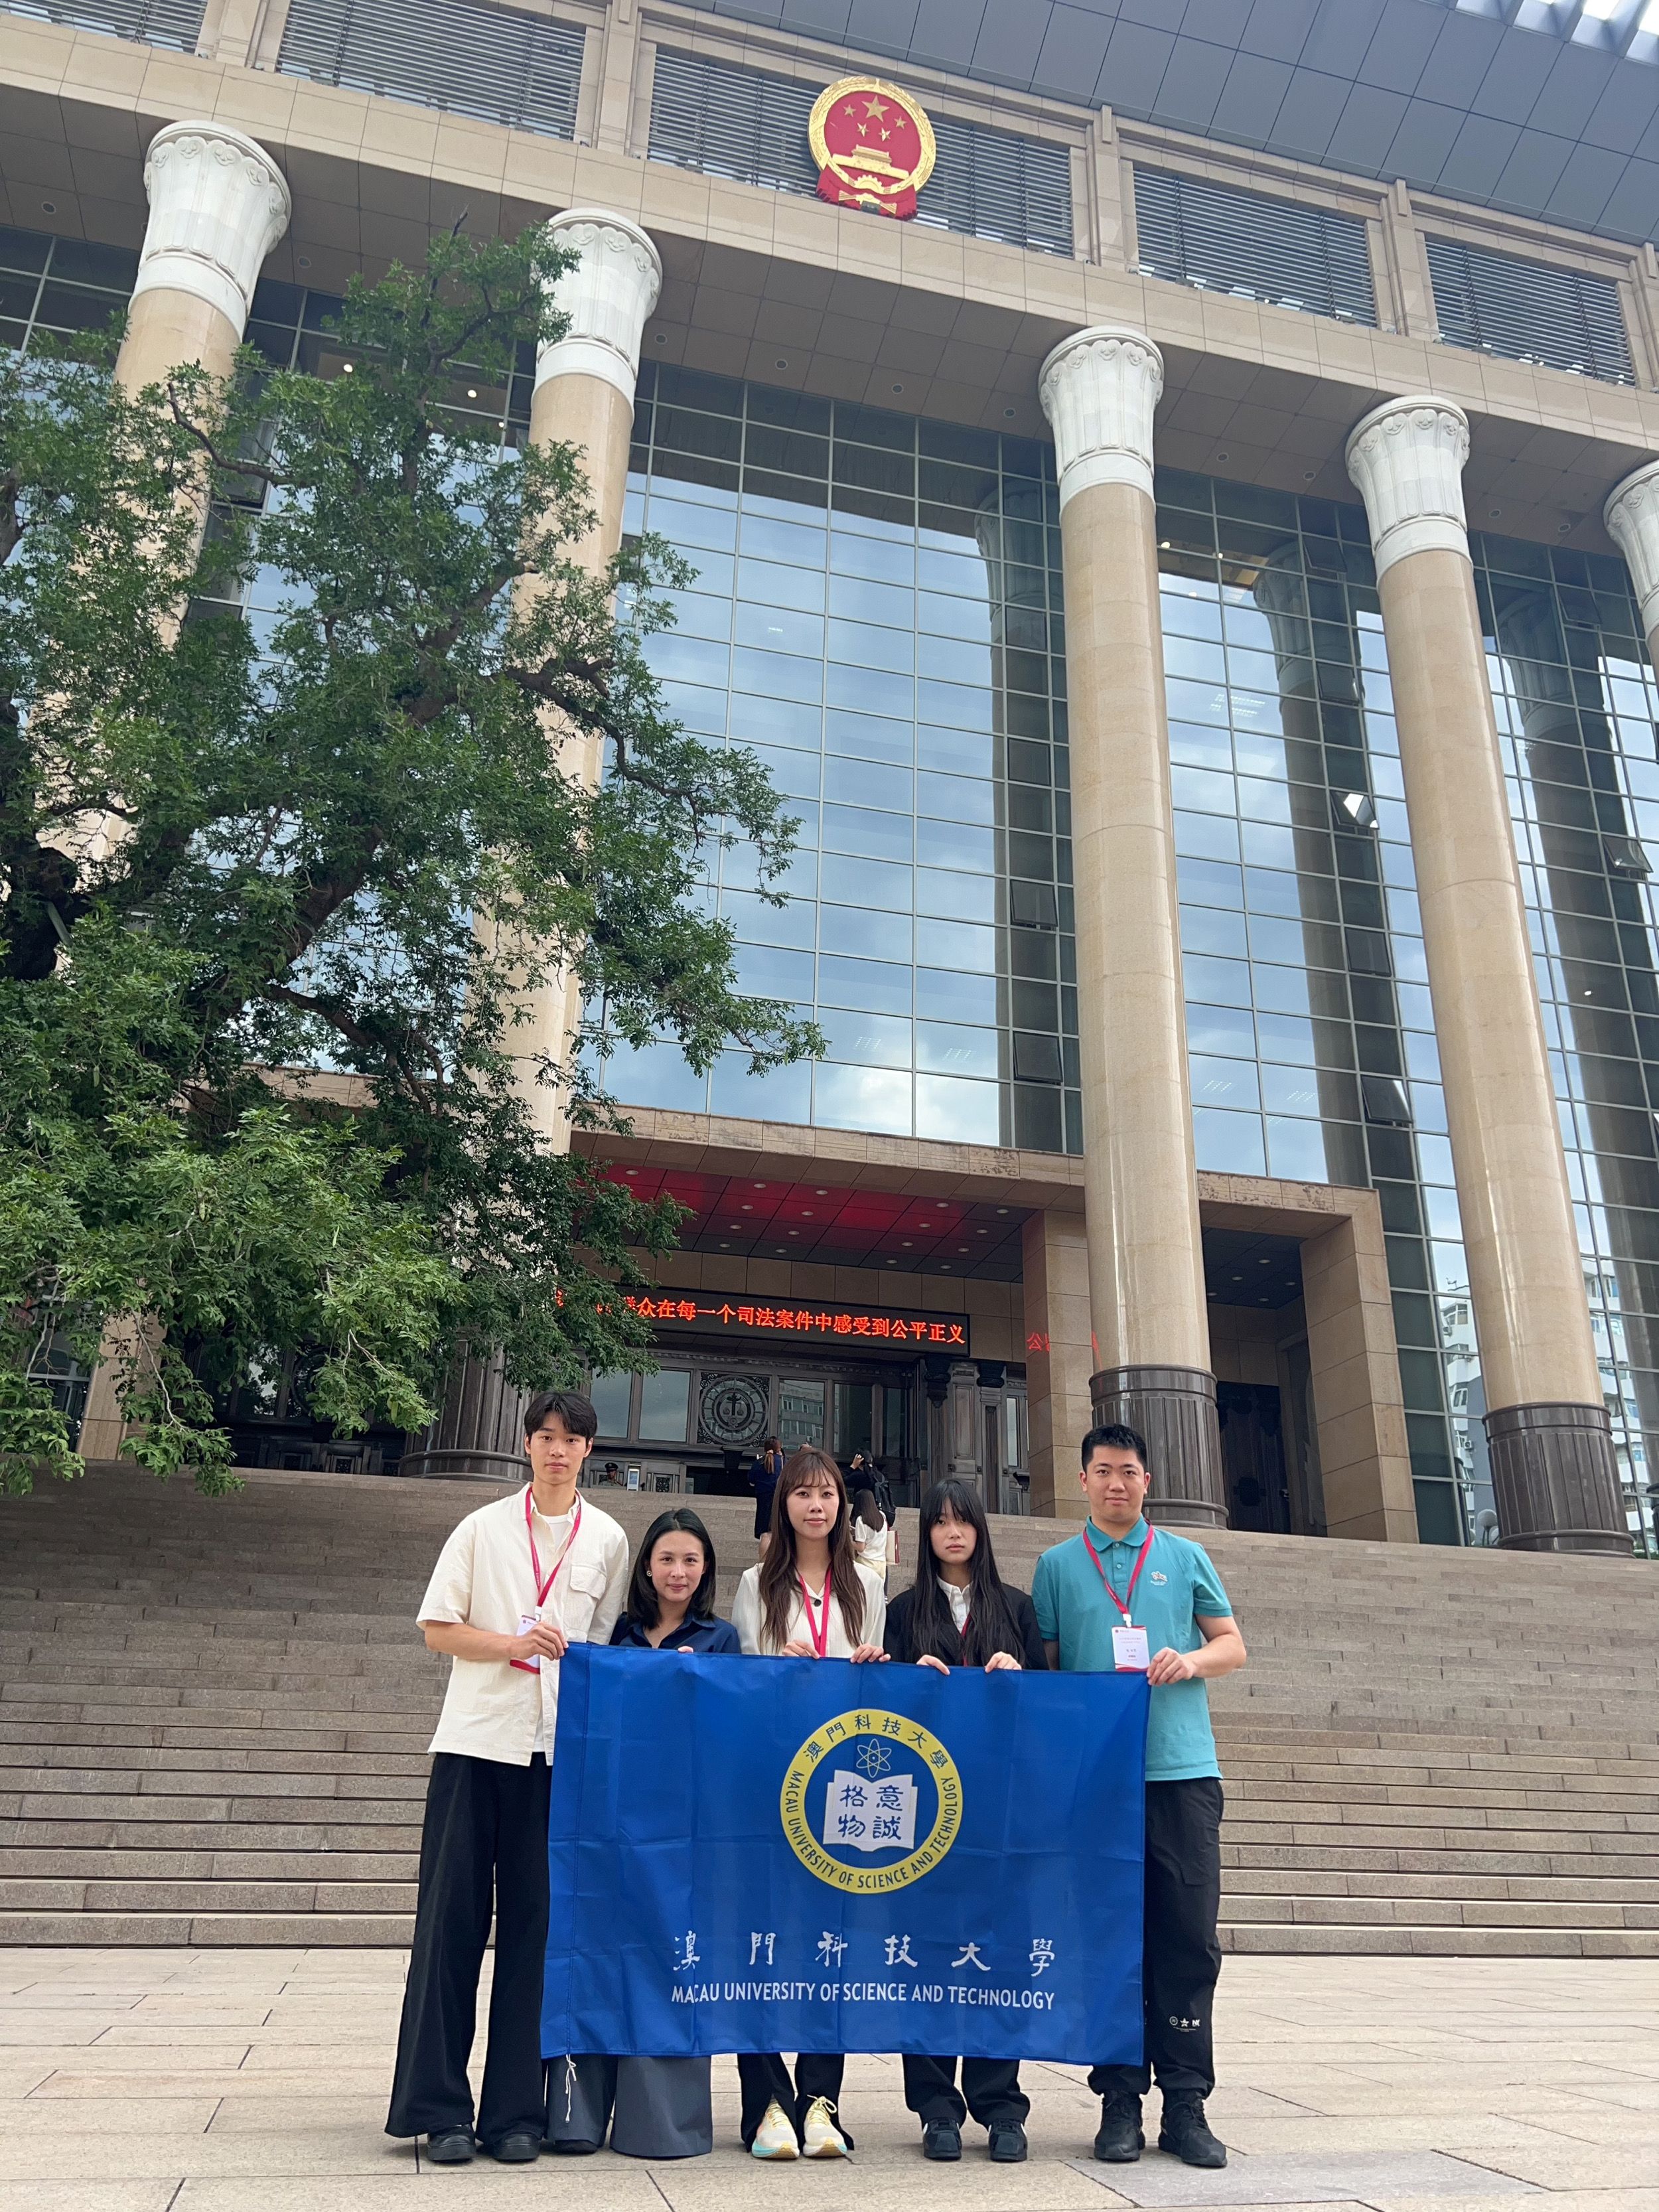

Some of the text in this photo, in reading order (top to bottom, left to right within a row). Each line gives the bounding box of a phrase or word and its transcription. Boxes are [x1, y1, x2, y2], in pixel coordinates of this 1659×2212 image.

[596, 1295, 966, 1344] 众在每一个司法案件中感受到公平正义
[803, 1714, 948, 1769] 澳門科技大學
[785, 1770, 958, 1889] MACAU UNIVERSITY OF SCIENCE AND TECHNOLOGY
[673, 1930, 1055, 1977] 澳門科技大學
[671, 1982, 1055, 2010] MACAU UNIVERSITY OF SCIENCE AND TECHNOLOGY
